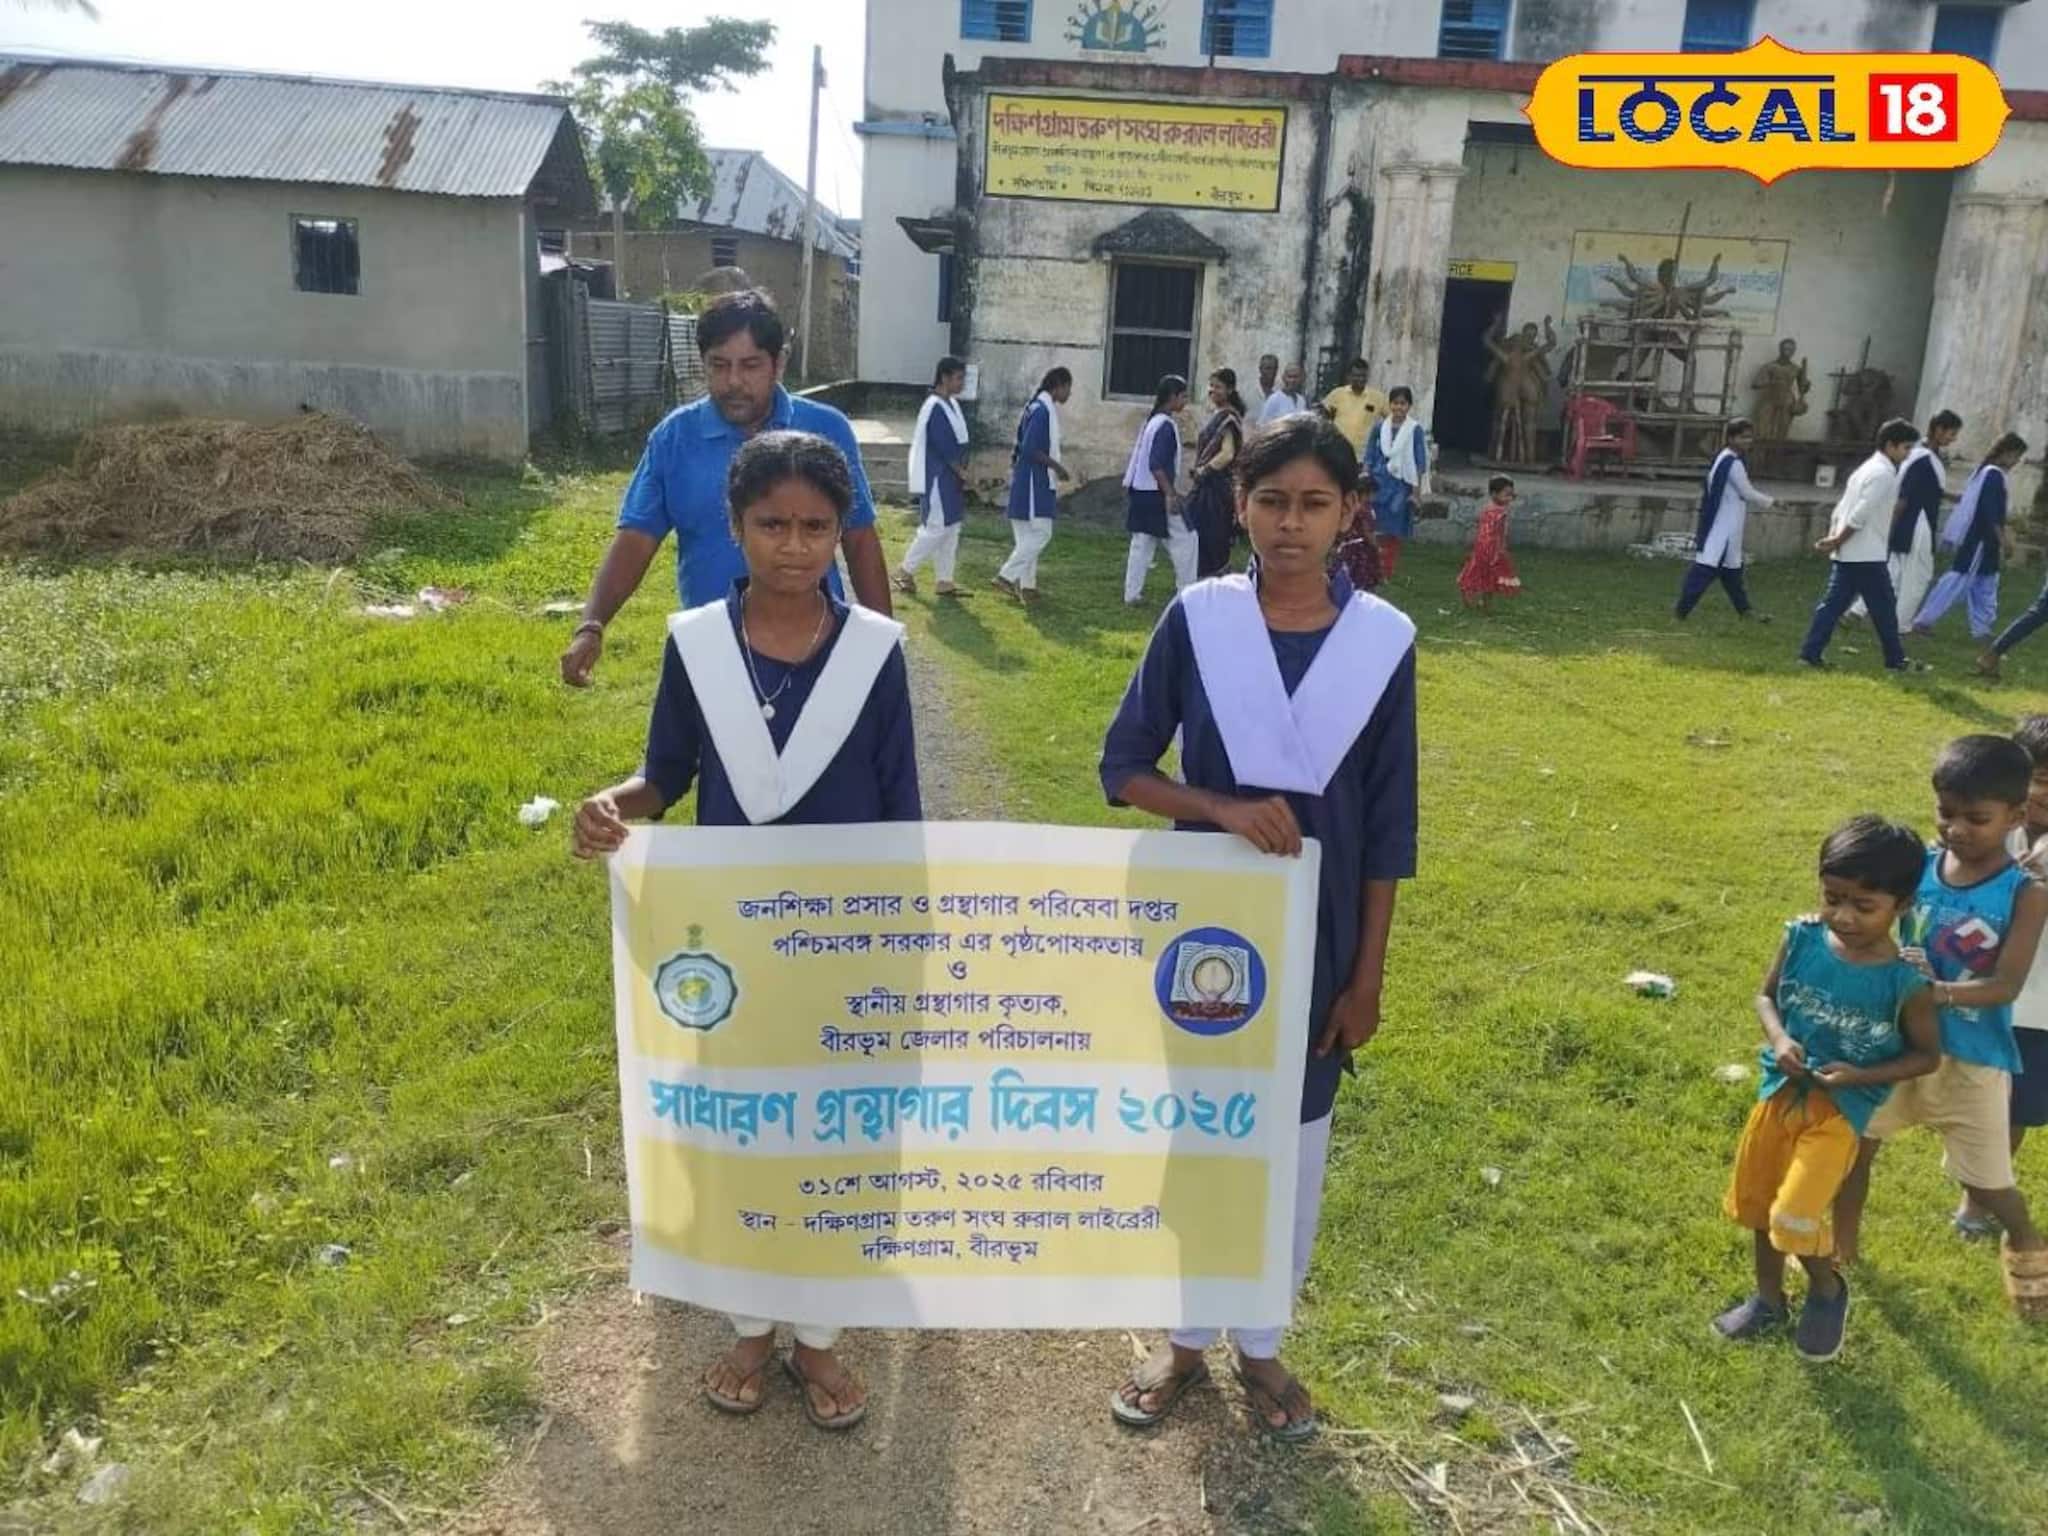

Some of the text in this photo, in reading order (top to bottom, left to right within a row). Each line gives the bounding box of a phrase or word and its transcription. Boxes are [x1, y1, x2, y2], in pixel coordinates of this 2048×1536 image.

[737, 890, 1180, 922] জনশিক্ষা প্রসার ও গ্রন্থাগার পরিষেবা দপ্তর
[773, 926, 1144, 958] পশ্চিমবঙ্গ সরকার এর পৃষ্ঠপোষকতায়
[947, 961, 968, 980] ও
[845, 986, 908, 1017] স্থানীয়
[913, 991, 991, 1017] গ্রন্থাগার
[820, 1023, 1093, 1058] বীরভূম জেলার পরিচালনায়
[650, 1067, 1258, 1146] সাধারণ গ্রন্থাগার দিবস ২০২৫
[800, 1166, 1105, 1196] ৩১শে আগস্ট, ২০২৫ রবিবার
[802, 1209, 897, 1233] দক্ষিণগ্রাম
[902, 1208, 956, 1228] তরুণ
[962, 1208, 1006, 1229] সংঘ
[1012, 1209, 1072, 1230] রুরাল
[1078, 1204, 1161, 1231] লাইব্রেরী
[861, 1233, 1039, 1264] দক্ষিণগ্রাম, বীরভূম
